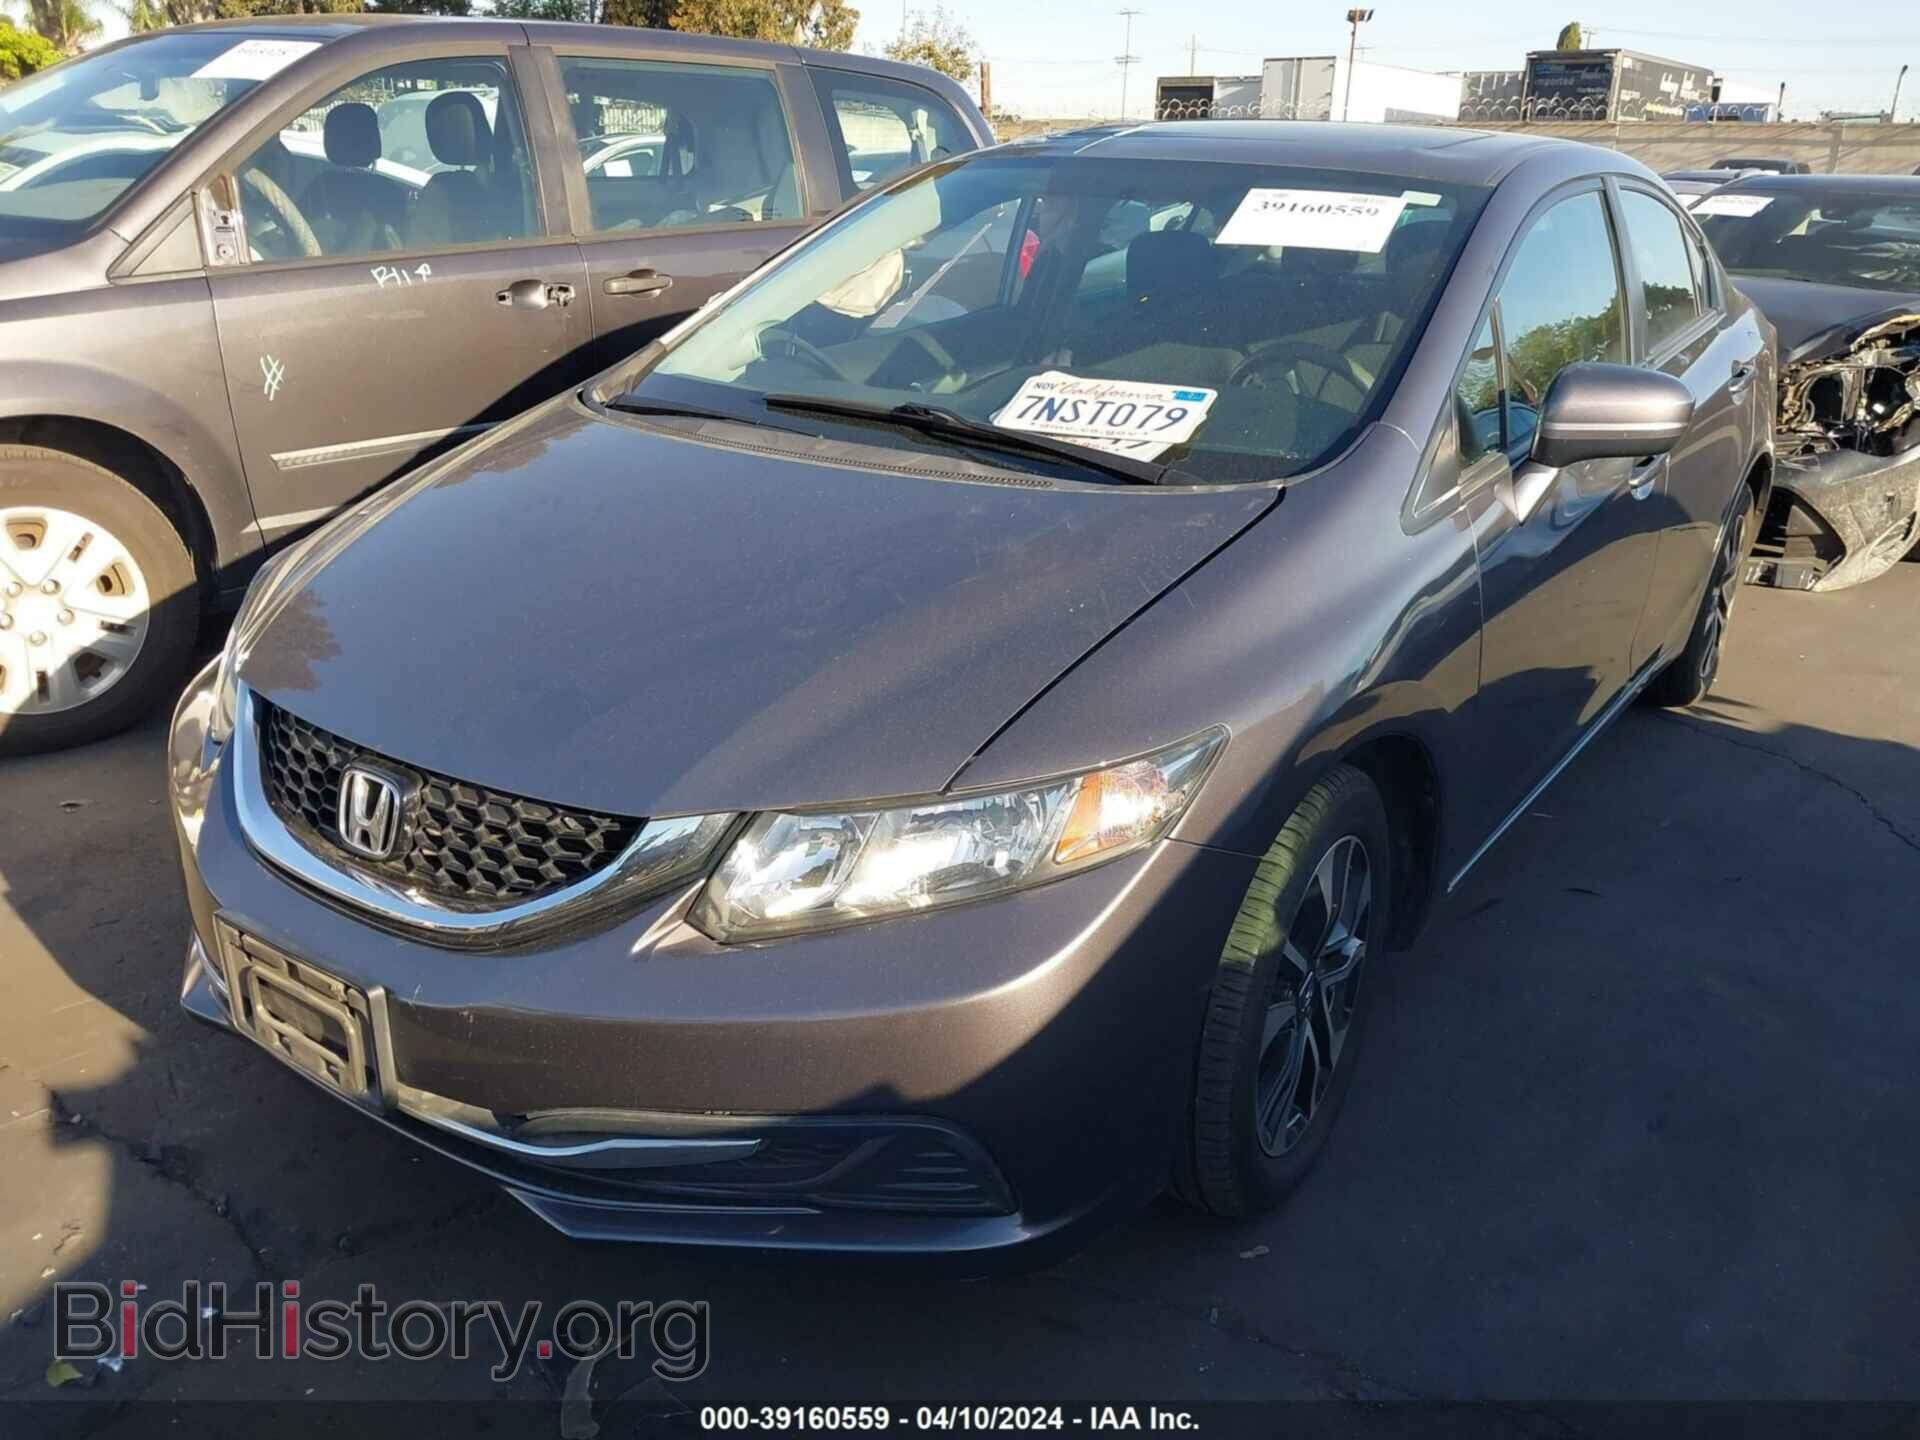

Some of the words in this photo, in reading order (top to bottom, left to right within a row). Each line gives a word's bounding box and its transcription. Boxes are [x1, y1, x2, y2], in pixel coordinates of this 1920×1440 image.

[1033, 381, 1058, 391] NOV
[1058, 381, 1164, 401] California
[1016, 395, 1189, 432] 7NST079
